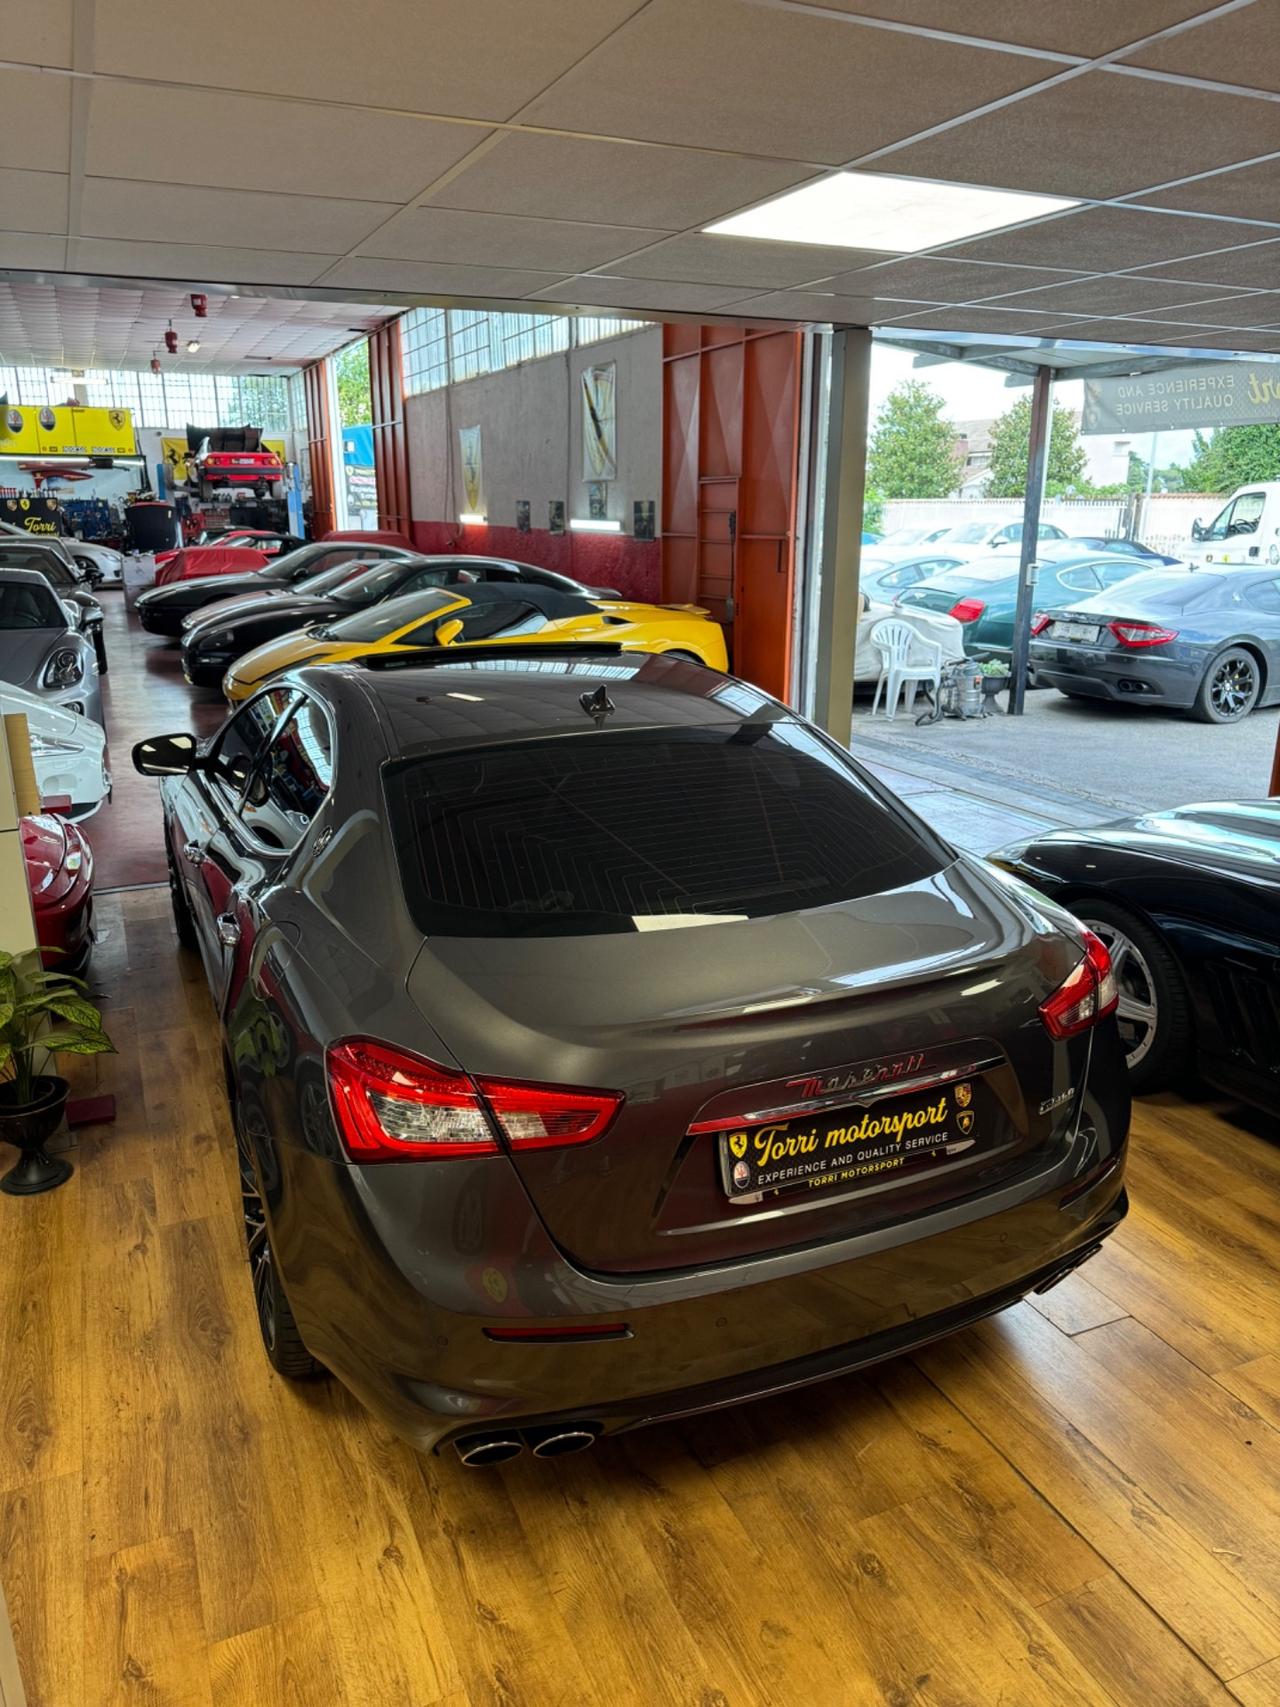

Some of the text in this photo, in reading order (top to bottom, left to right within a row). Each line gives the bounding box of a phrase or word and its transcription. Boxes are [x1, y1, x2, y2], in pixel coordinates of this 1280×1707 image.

[24, 516, 57, 534] Torri
[753, 1097, 949, 1167] Torri motorsport
[757, 1131, 949, 1186] EXPERIENCE AND QUALITY SERVICE
[808, 1157, 906, 1189] TORRI MOTORSPORT
